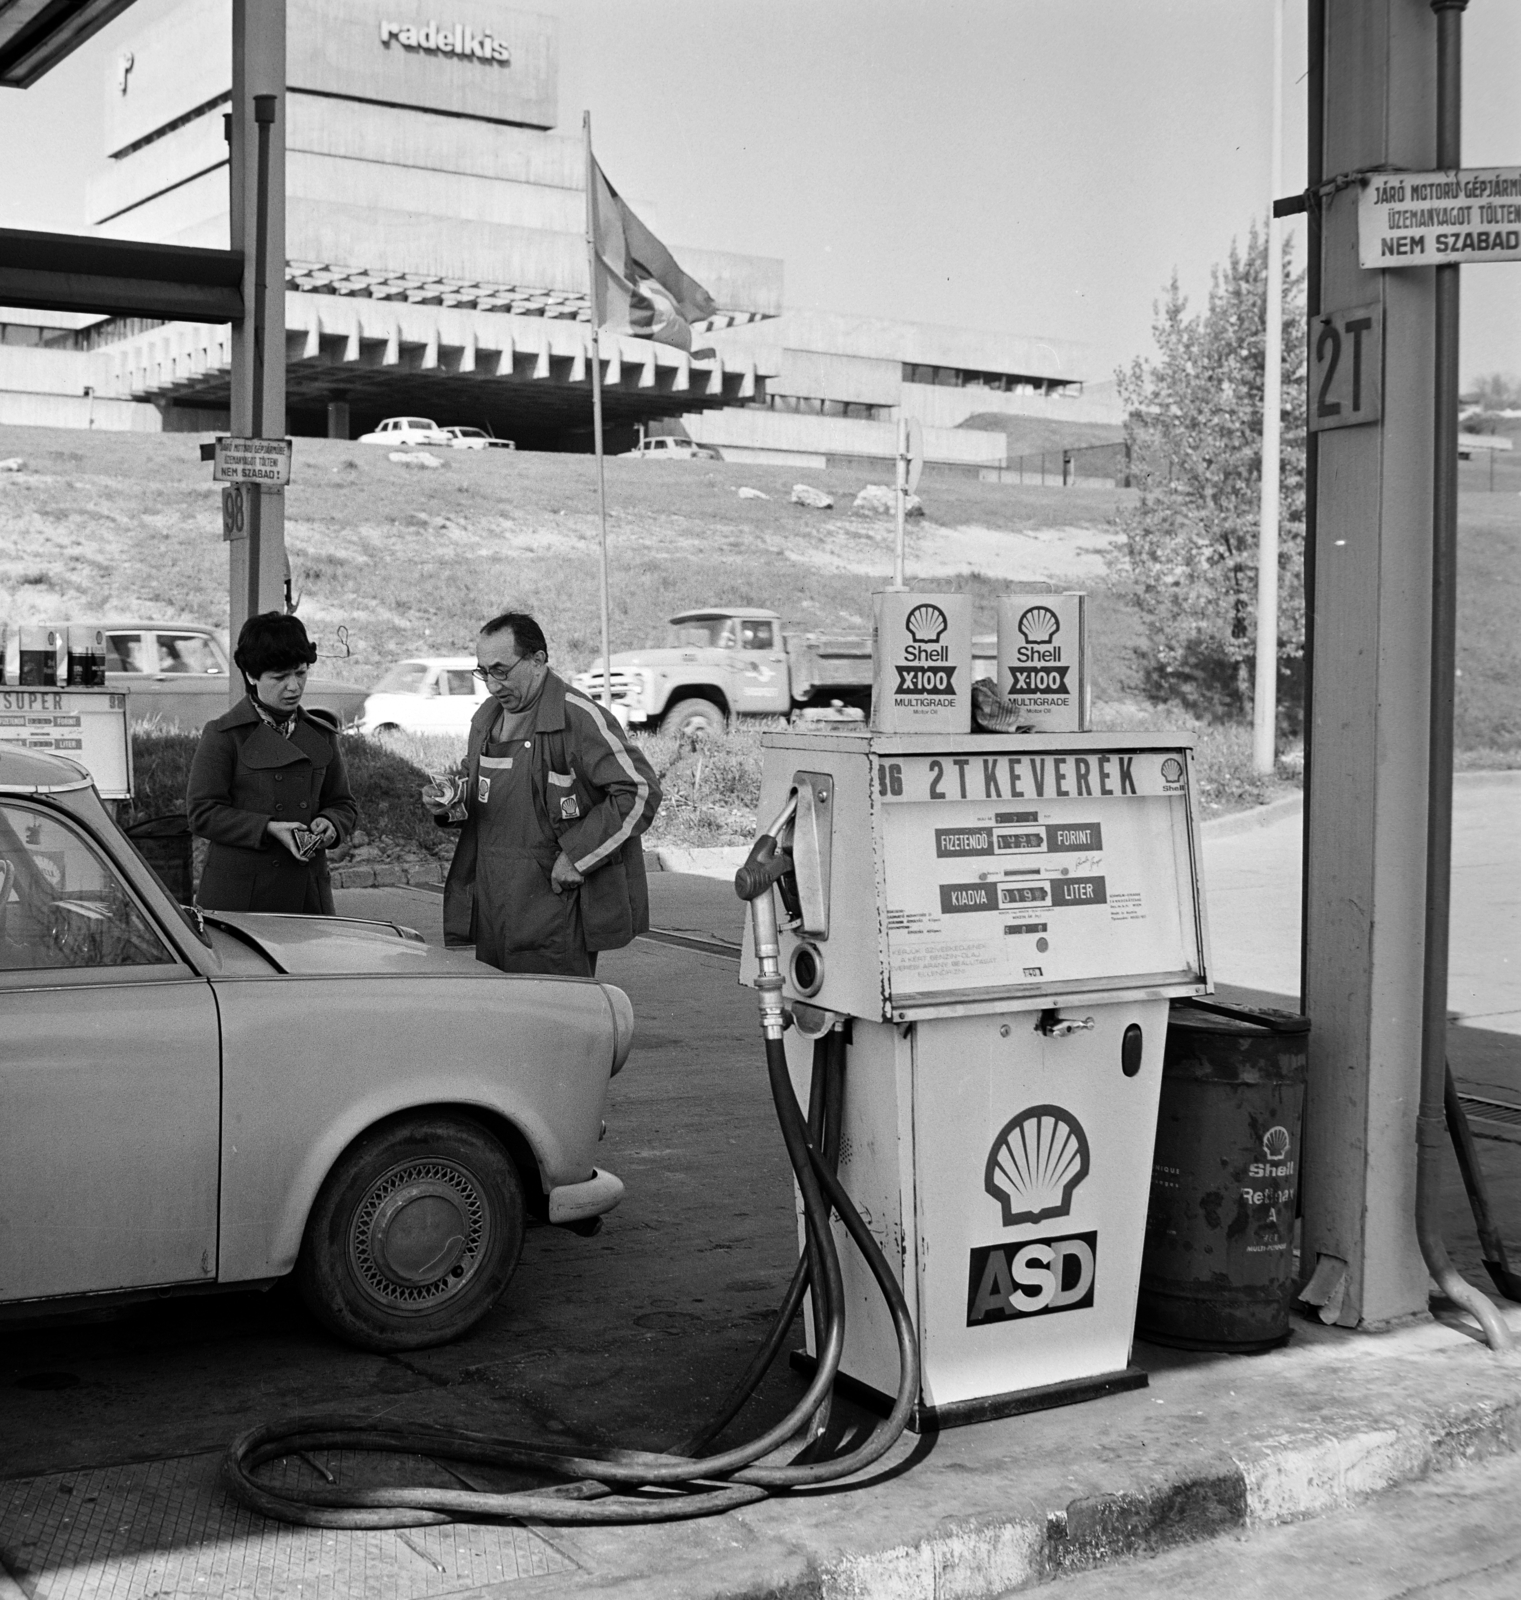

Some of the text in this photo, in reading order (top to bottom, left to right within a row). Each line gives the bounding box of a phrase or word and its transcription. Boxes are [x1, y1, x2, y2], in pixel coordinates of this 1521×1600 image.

[380, 20, 511, 62] radelkis
[1373, 180, 1405, 205] JÁRÓ
[1387, 205, 1473, 230] ÜZEMANYAGOT
[1381, 230, 1520, 257] NEM SZABAD
[1316, 317, 1372, 418] 2T
[221, 467, 238, 477] NEM
[225, 490, 244, 533] 98
[904, 645, 949, 662] Shell
[1017, 646, 1061, 663] Shell
[902, 671, 948, 690] X-100
[1015, 671, 1060, 690] X-100
[3, 692, 62, 710] SUPER
[894, 698, 956, 707] MULTIGRADE
[982, 754, 1137, 798] KEVERÉK
[1057, 830, 1091, 845] FORINT
[951, 889, 988, 906] KIADVA
[1063, 883, 1094, 900] LITER
[1249, 1161, 1294, 1177] Shell
[1267, 1207, 1277, 1222] A
[969, 1239, 1095, 1321] ASD
